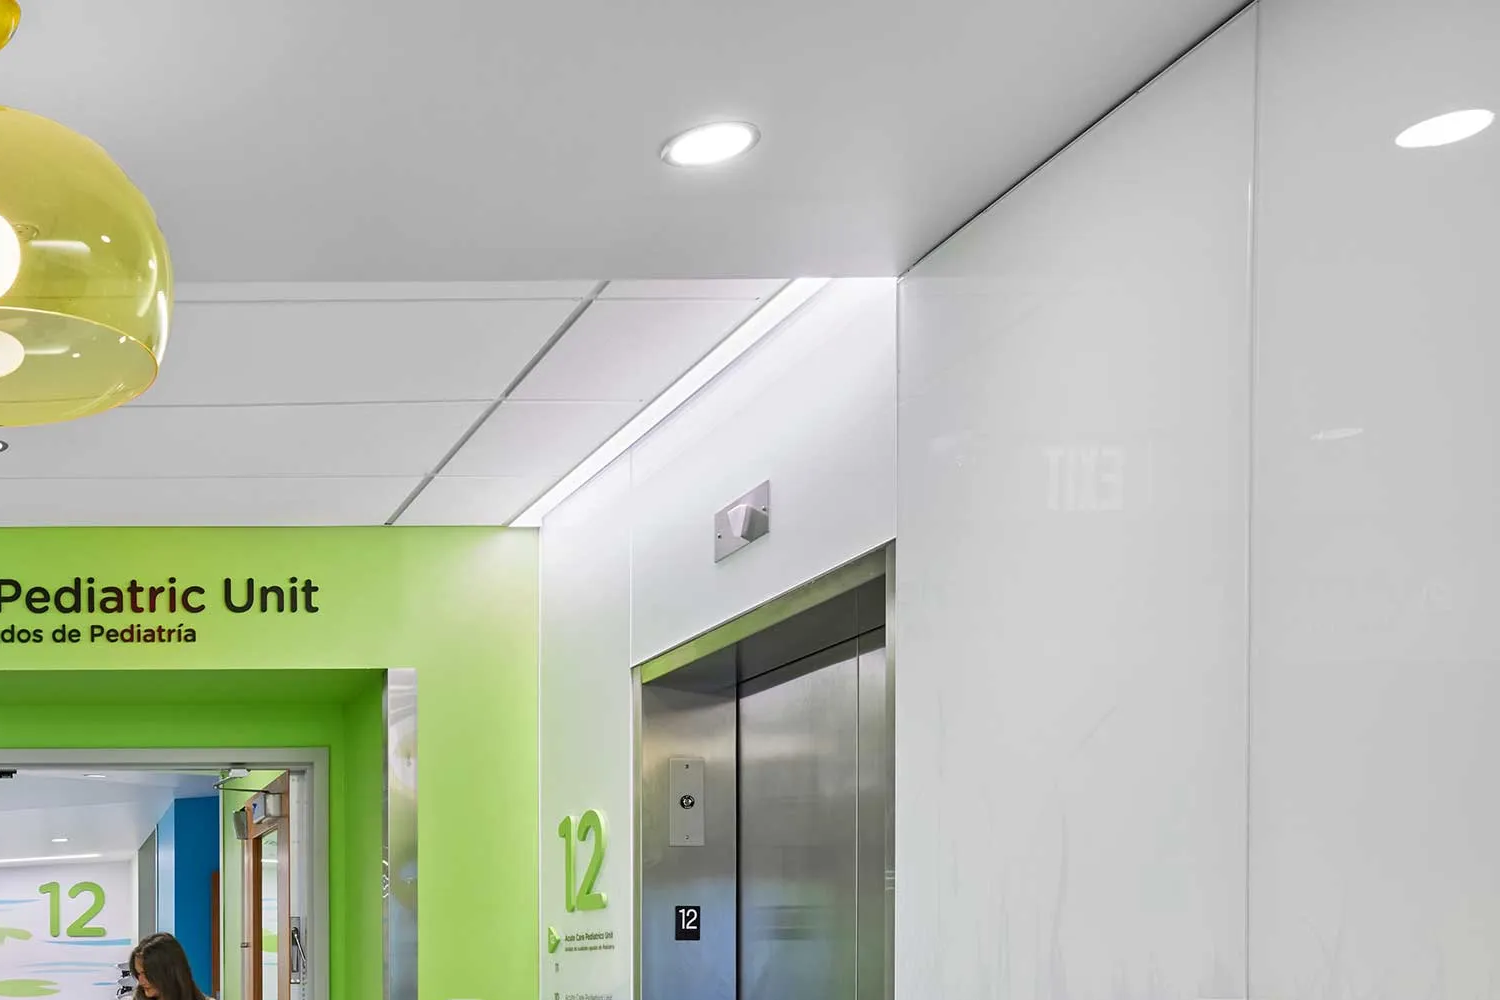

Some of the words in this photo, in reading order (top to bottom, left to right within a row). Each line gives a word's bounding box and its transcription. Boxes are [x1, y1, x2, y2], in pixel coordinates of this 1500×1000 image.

[224, 577, 320, 613] Unit
[52, 624, 81, 643] de
[90, 623, 197, 643] Pediatría
[558, 809, 608, 912] 12
[38, 882, 108, 937] 12
[678, 908, 698, 930] 12
